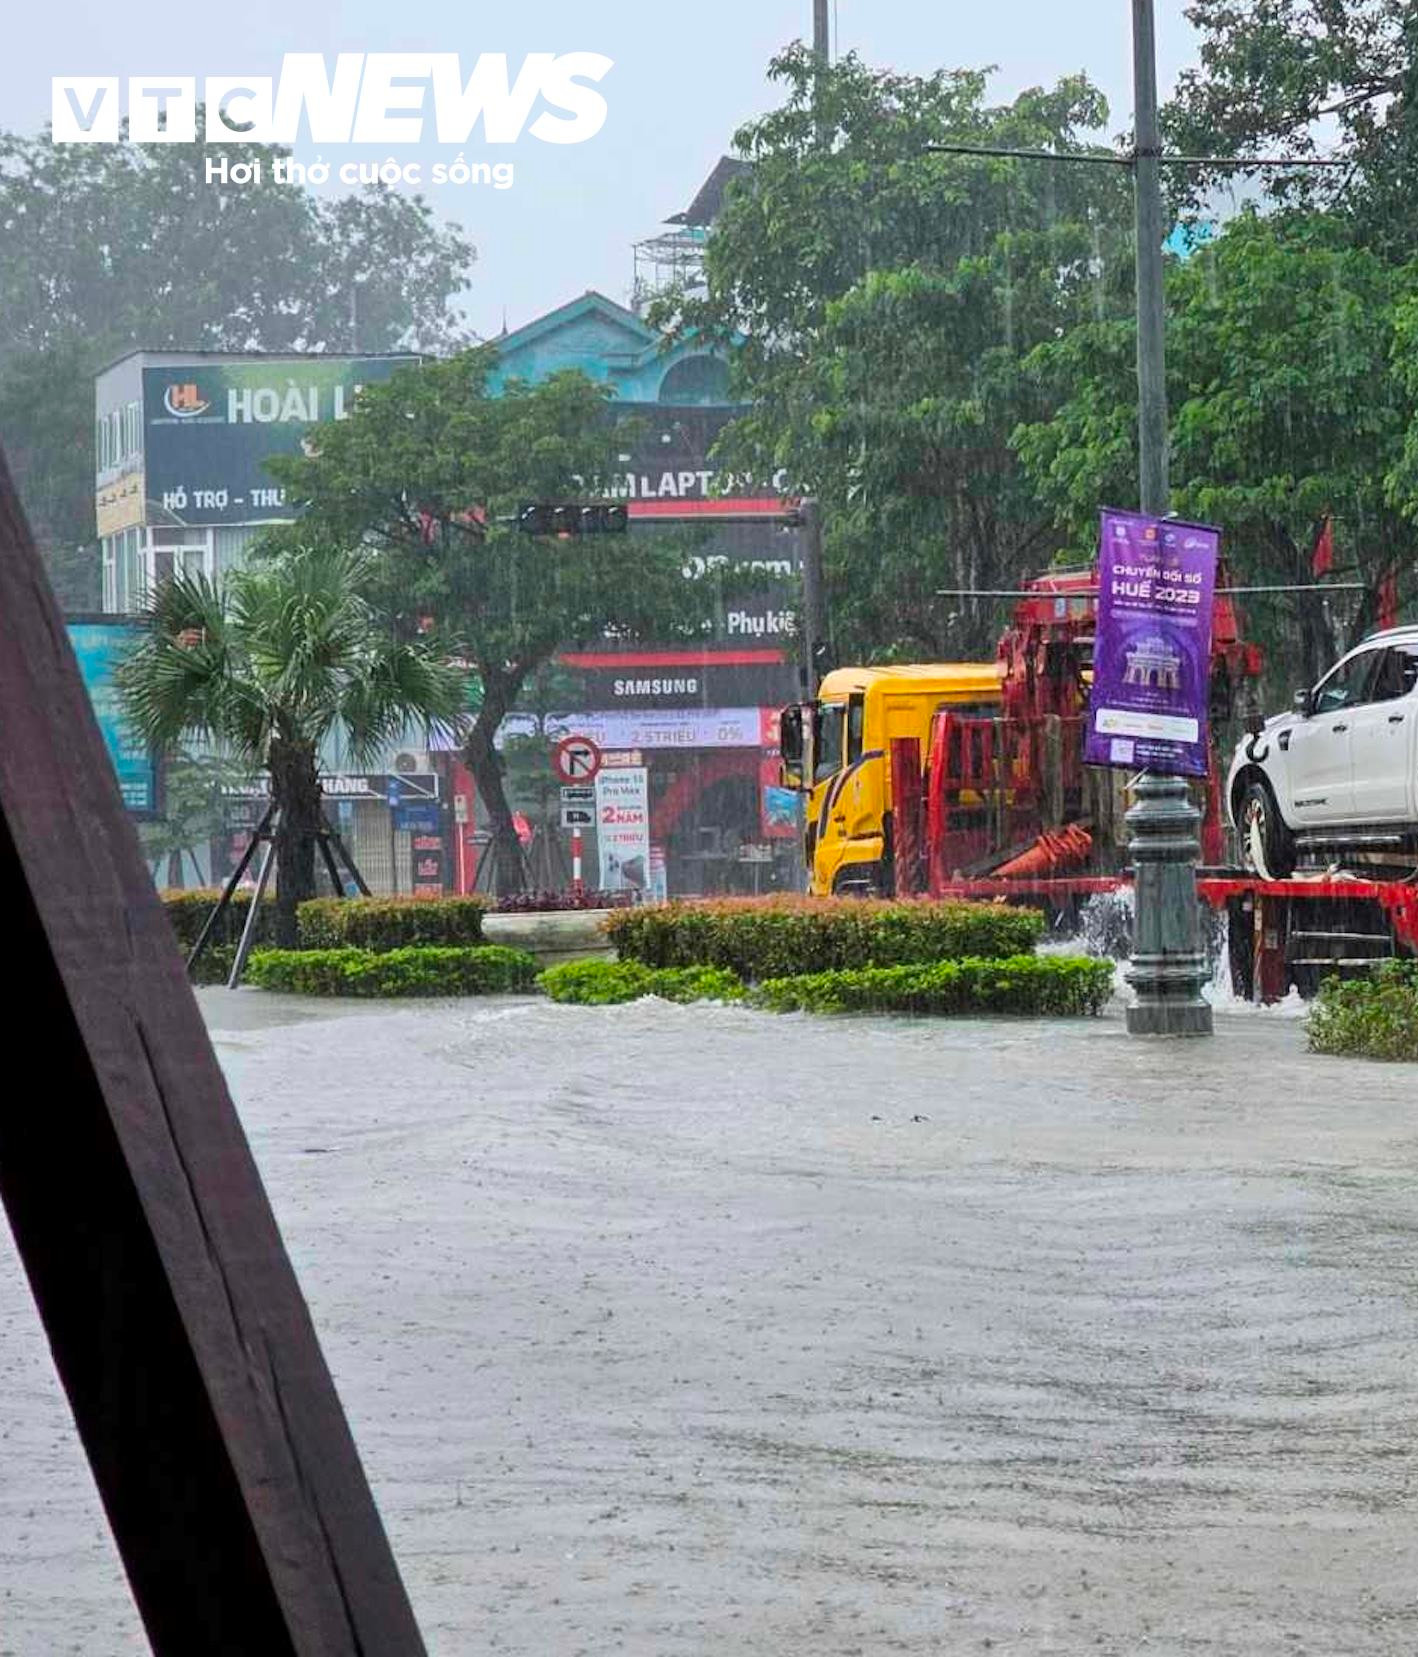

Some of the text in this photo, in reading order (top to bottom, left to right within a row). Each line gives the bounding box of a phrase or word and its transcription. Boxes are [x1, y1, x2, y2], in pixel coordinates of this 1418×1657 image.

[227, 378, 319, 424] HOÀI
[1112, 580, 1200, 604] HUẾ 2023
[727, 610, 765, 636] Phụ
[613, 678, 699, 697] SAMSUNG
[602, 805, 615, 824] 2
